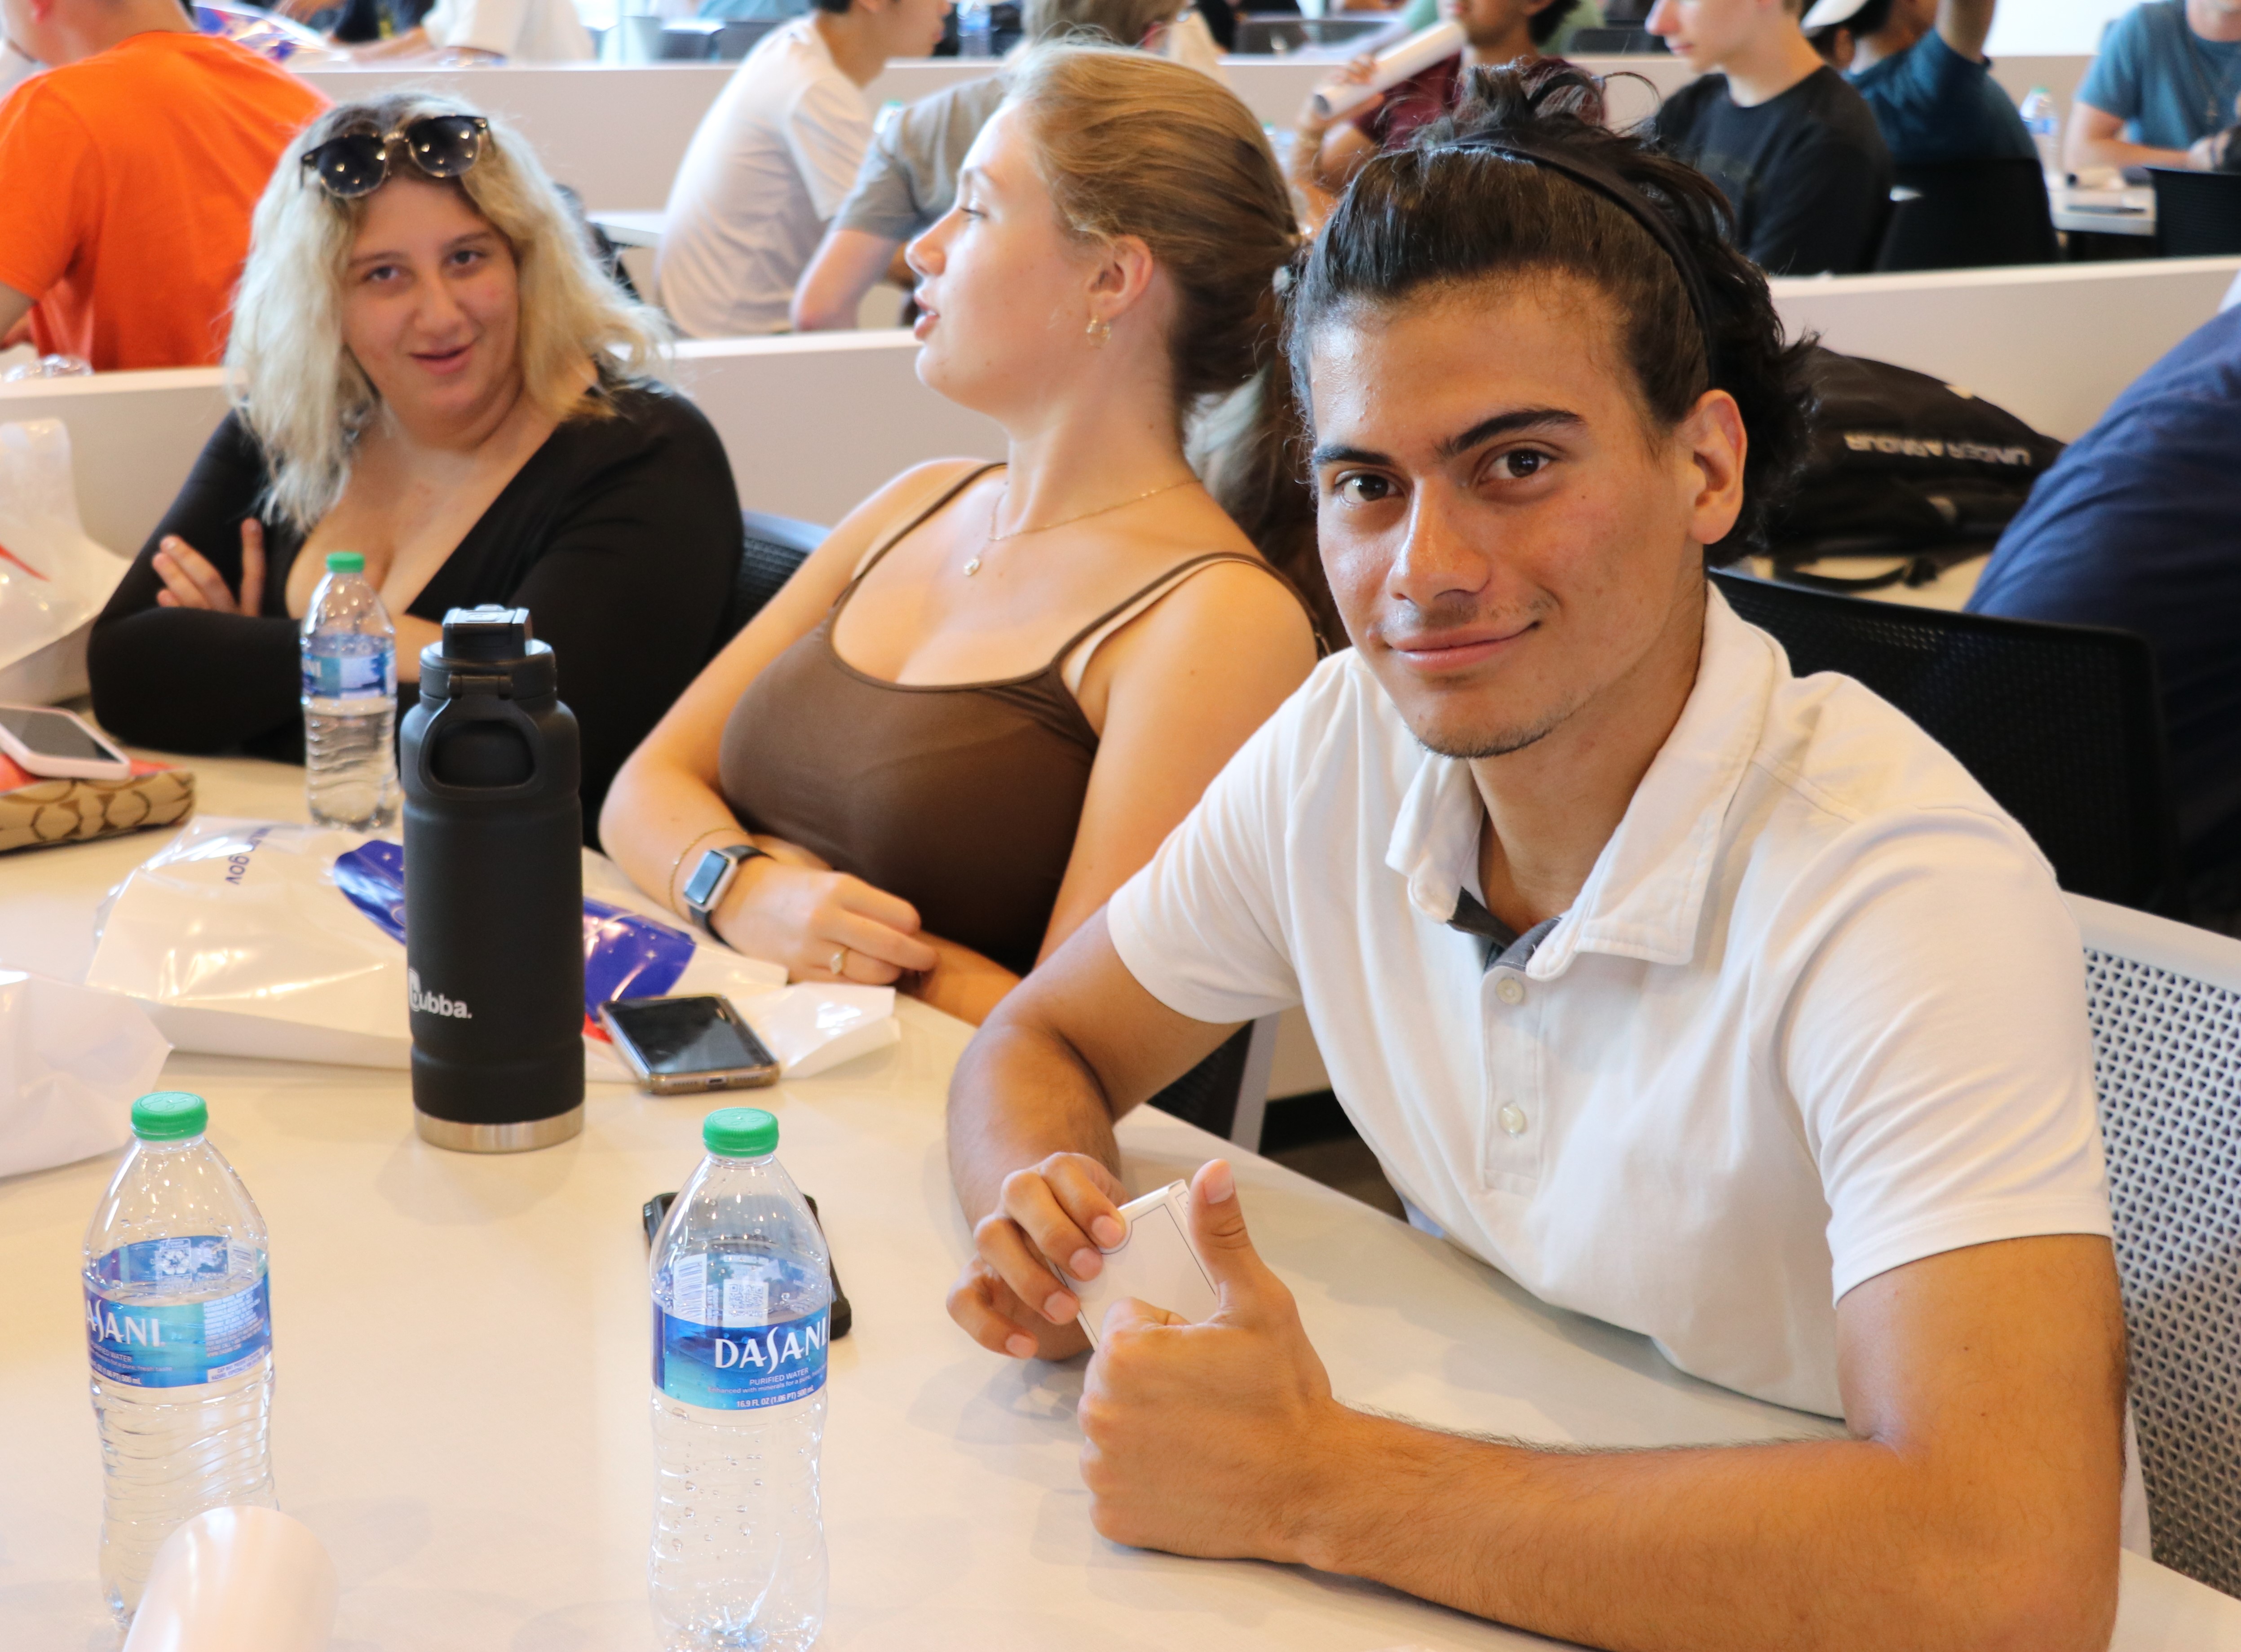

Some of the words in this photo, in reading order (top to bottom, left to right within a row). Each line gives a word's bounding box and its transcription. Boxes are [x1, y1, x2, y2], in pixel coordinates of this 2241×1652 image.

[87, 1299, 160, 1347] ASANI
[715, 1317, 827, 1374] DASANI
[749, 1374, 785, 1386] PURIFIED
[786, 1367, 809, 1380] WATER
[758, 1382, 785, 1392] minerals
[786, 1391, 796, 1400] PT)
[797, 1388, 807, 1397] 500
